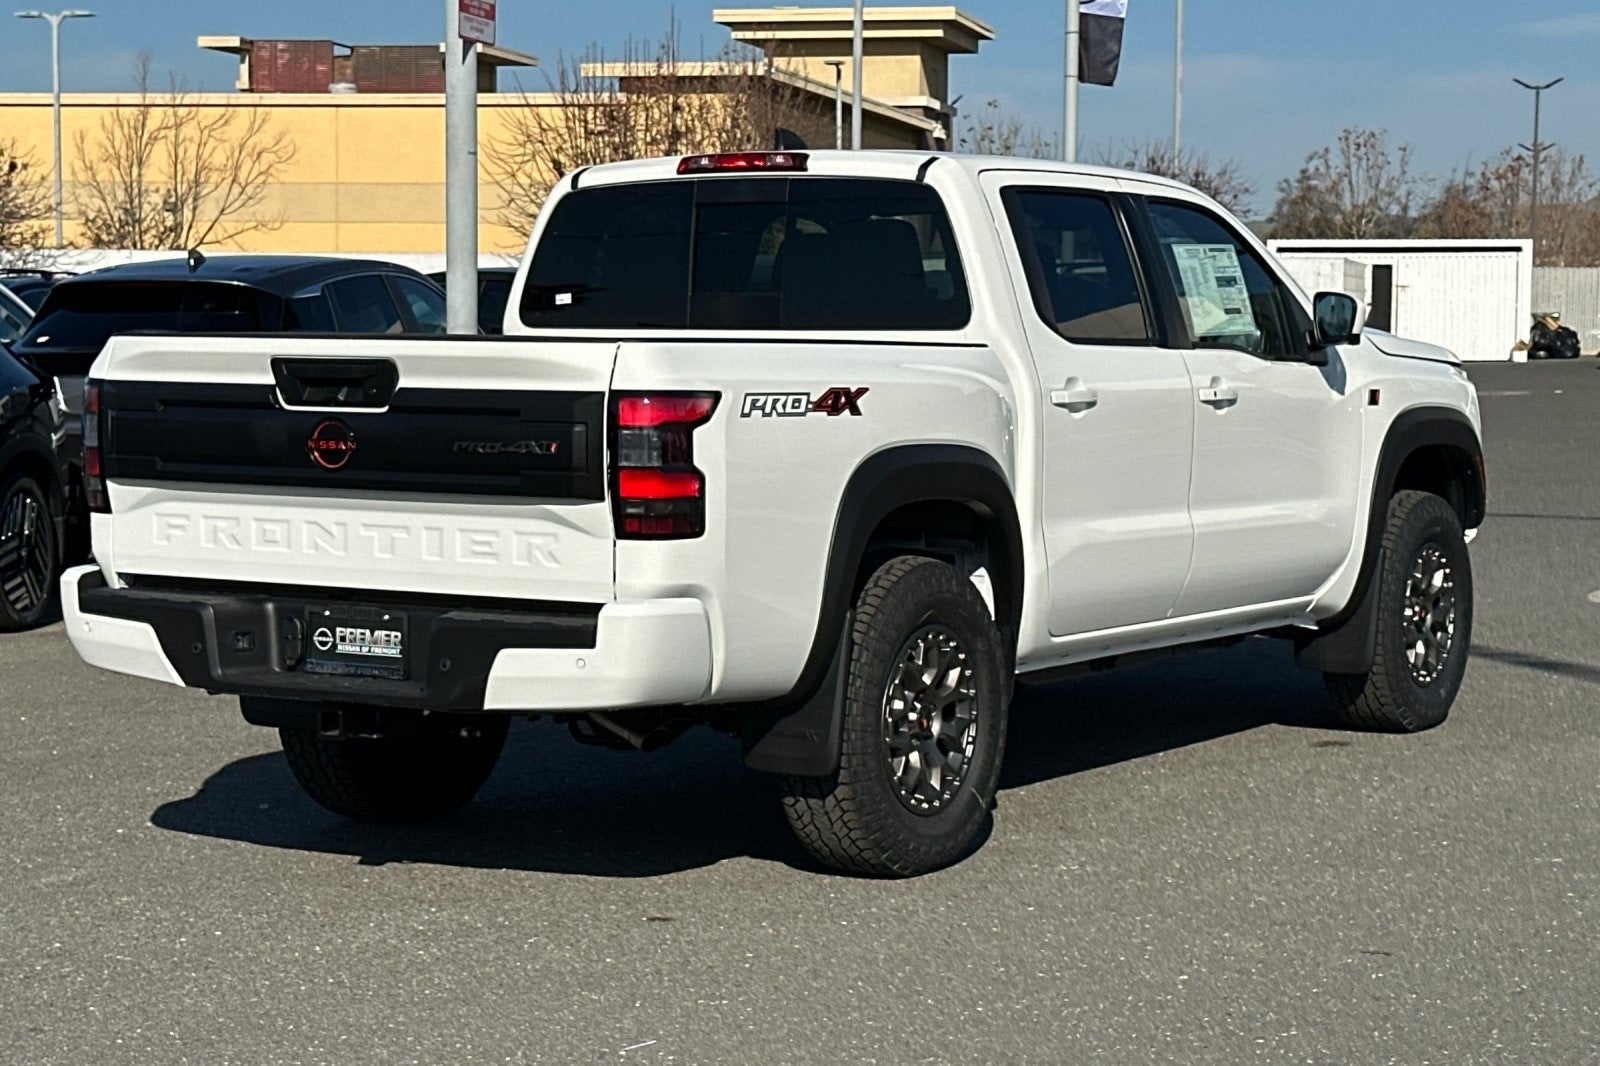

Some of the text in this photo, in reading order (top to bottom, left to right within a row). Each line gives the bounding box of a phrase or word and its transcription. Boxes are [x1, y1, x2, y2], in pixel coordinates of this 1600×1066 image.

[740, 387, 870, 418] PRO-4X
[308, 439, 356, 451] NISSAN
[152, 512, 562, 569] FRONTIER
[335, 627, 402, 648] PREMIER
[337, 644, 361, 653] NISSAN
[370, 647, 401, 656] FREMONT
